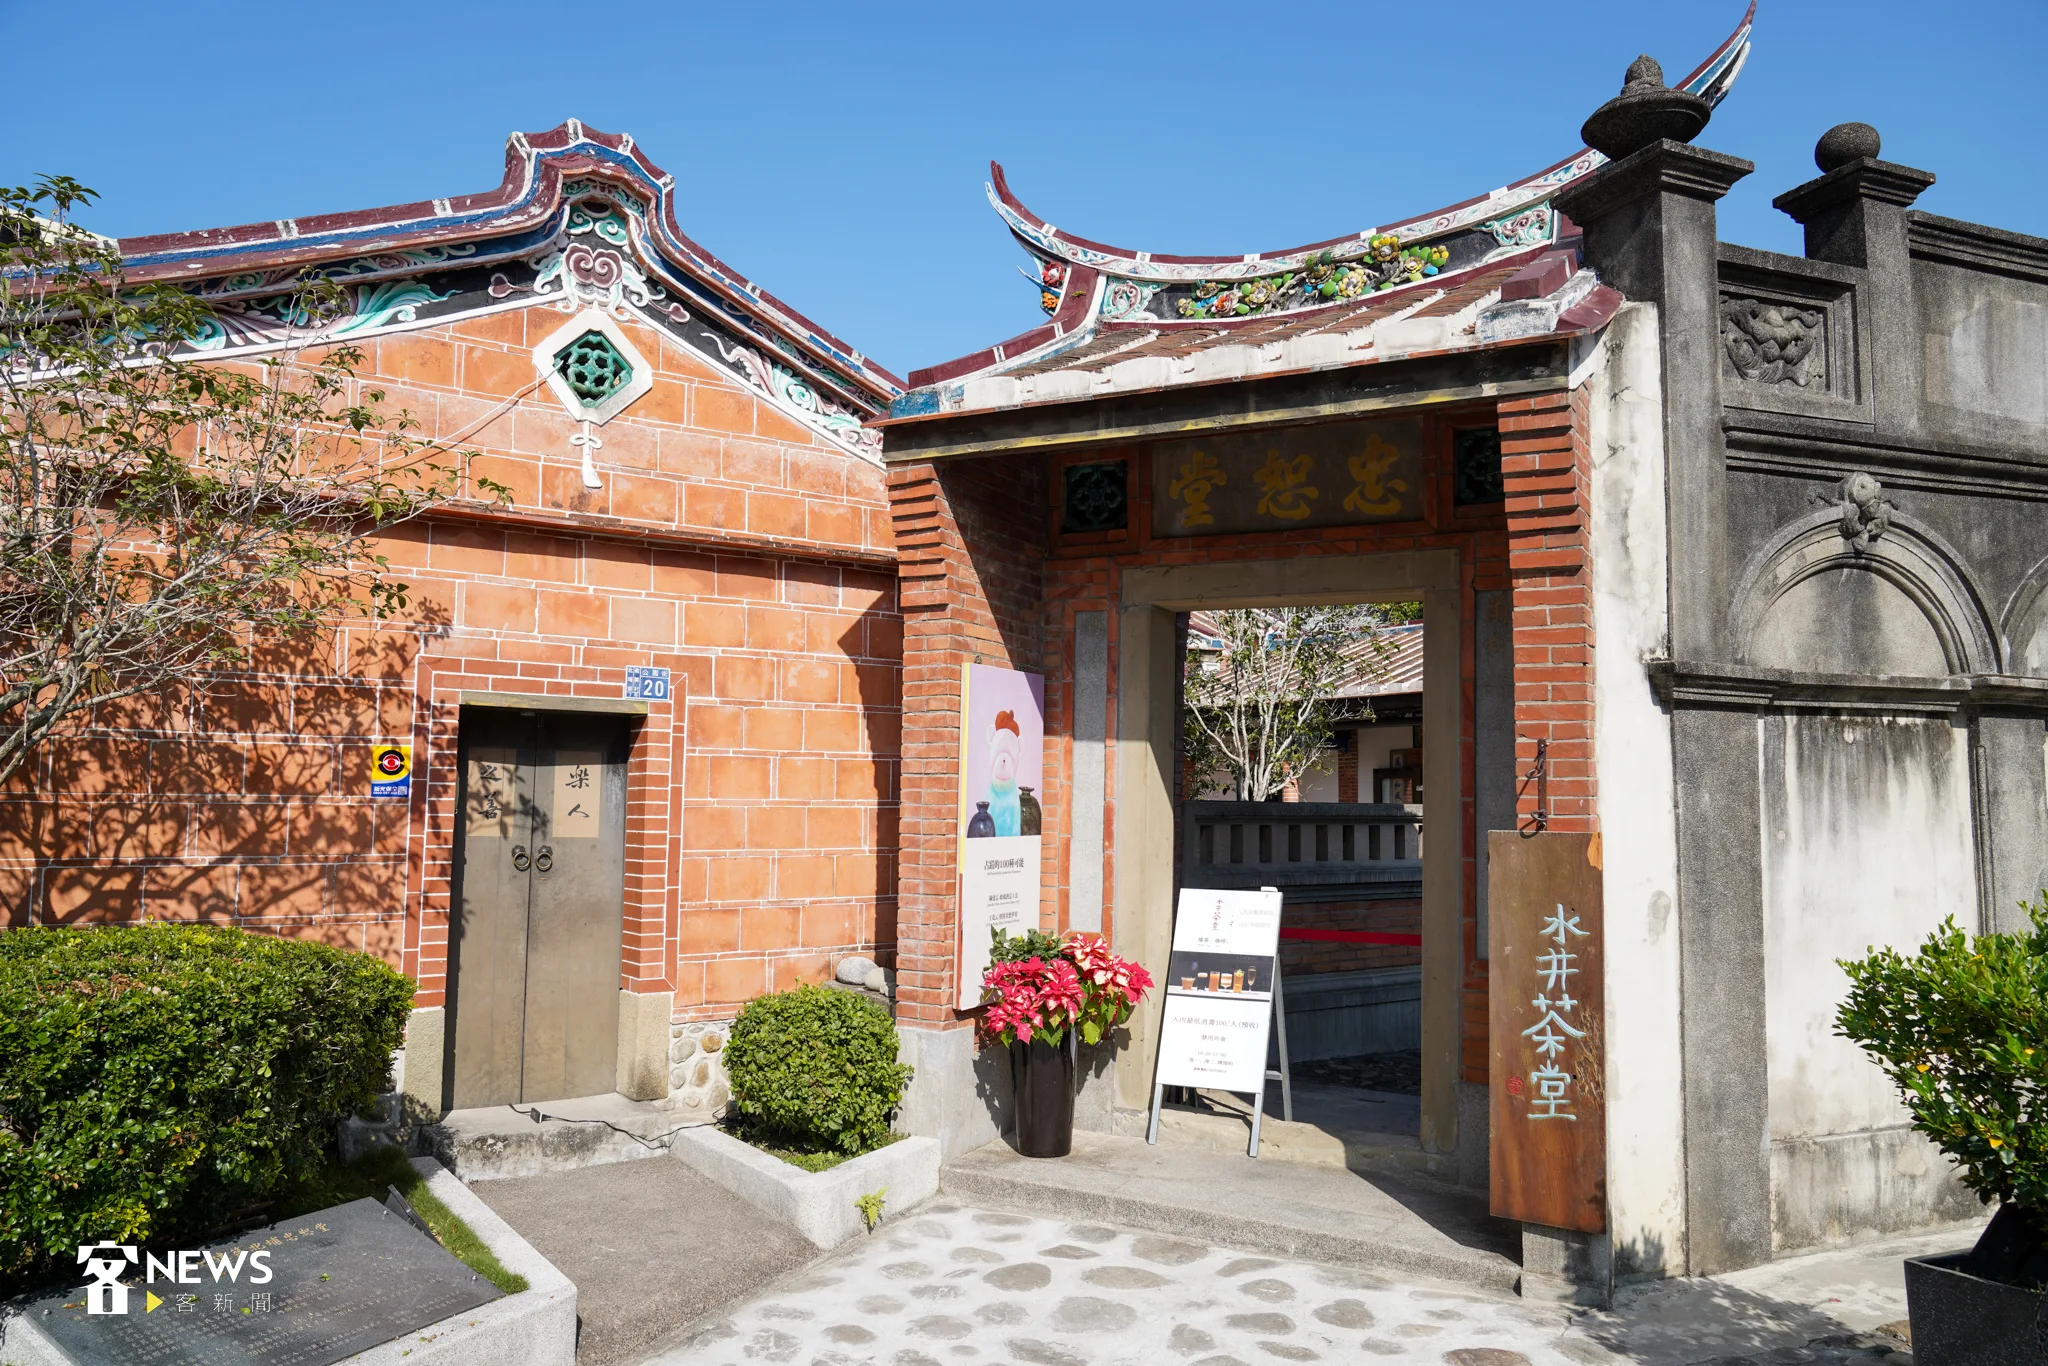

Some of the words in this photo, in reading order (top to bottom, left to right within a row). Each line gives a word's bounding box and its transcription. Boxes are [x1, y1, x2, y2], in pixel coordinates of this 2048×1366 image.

[1169, 433, 1407, 528] 忠恕堂
[642, 668, 668, 677] 公園街
[643, 679, 664, 697] 20
[1521, 903, 1590, 1121] 水井茶堂
